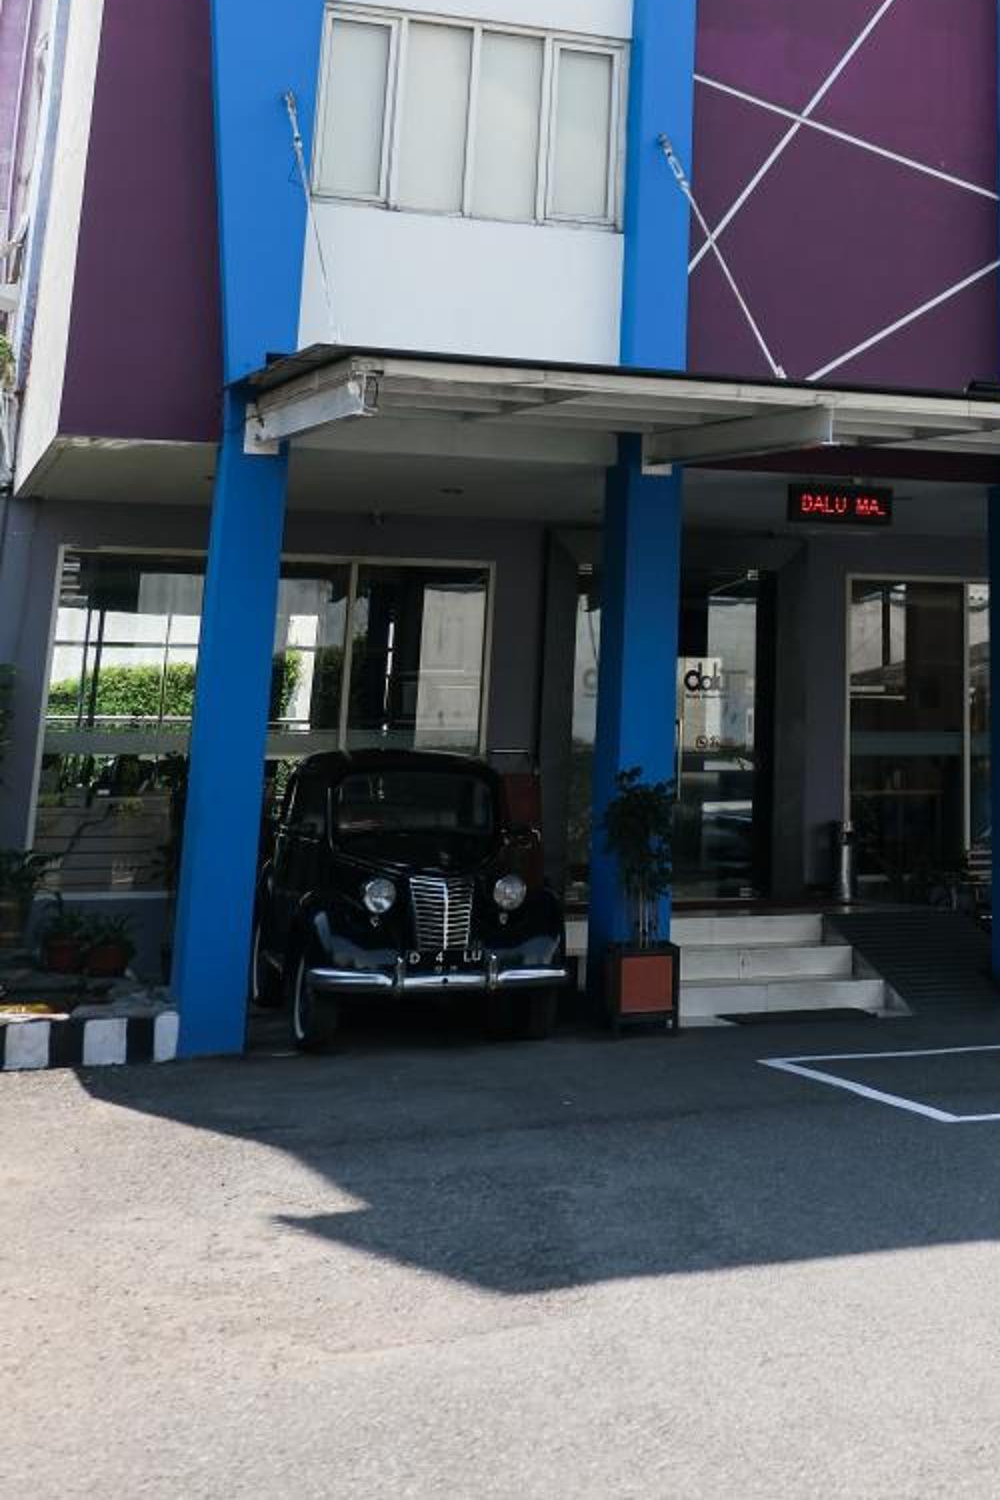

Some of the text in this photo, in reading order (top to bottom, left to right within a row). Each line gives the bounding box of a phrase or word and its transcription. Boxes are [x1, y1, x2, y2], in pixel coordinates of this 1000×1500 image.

[801, 493, 847, 514] DALU
[409, 949, 482, 965] D 4 LU
